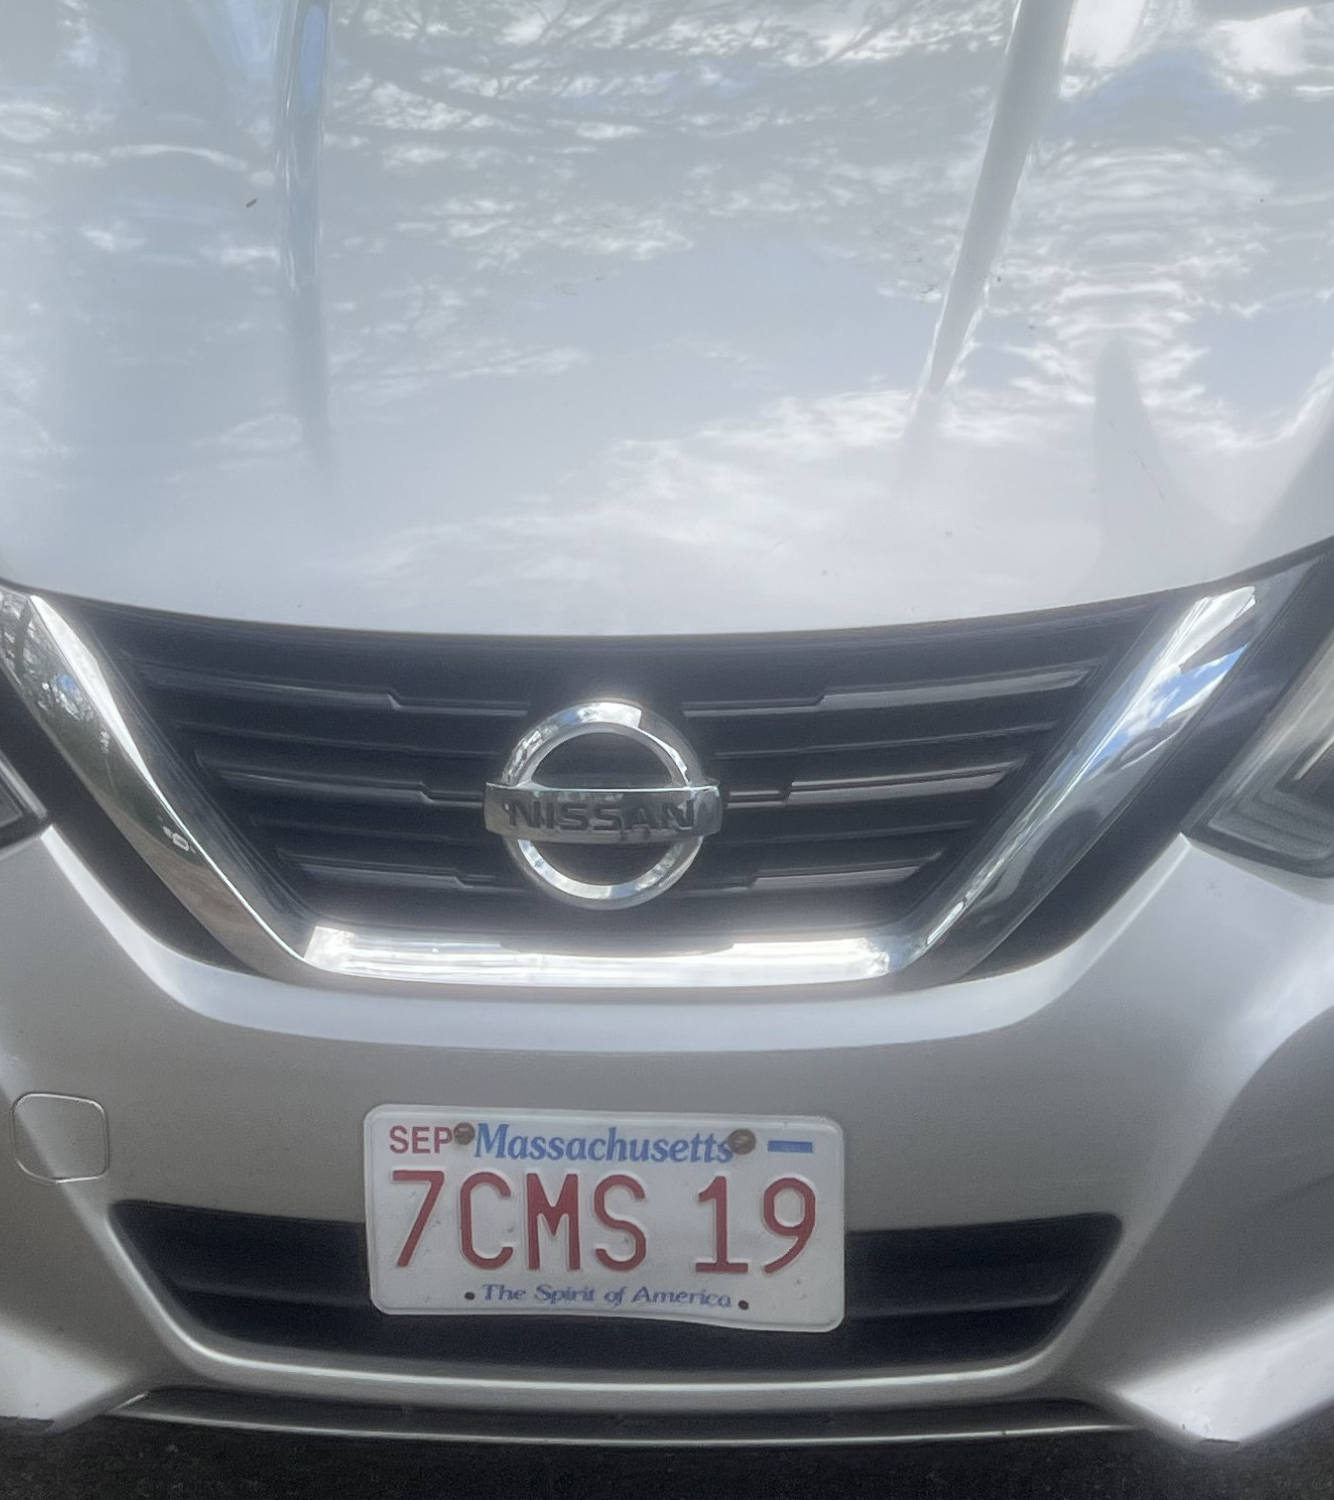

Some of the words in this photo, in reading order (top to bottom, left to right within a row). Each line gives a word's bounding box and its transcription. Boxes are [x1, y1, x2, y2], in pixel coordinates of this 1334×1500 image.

[503, 799, 695, 831] NISSAN
[389, 1125, 453, 1155] SEP
[474, 1122, 733, 1164] Massachusetts
[392, 1170, 647, 1273] 7CMS
[695, 1175, 816, 1275] 19
[482, 1283, 527, 1301] The
[534, 1284, 595, 1305] Spirit
[604, 1286, 628, 1306] of
[632, 1286, 733, 1309] America
